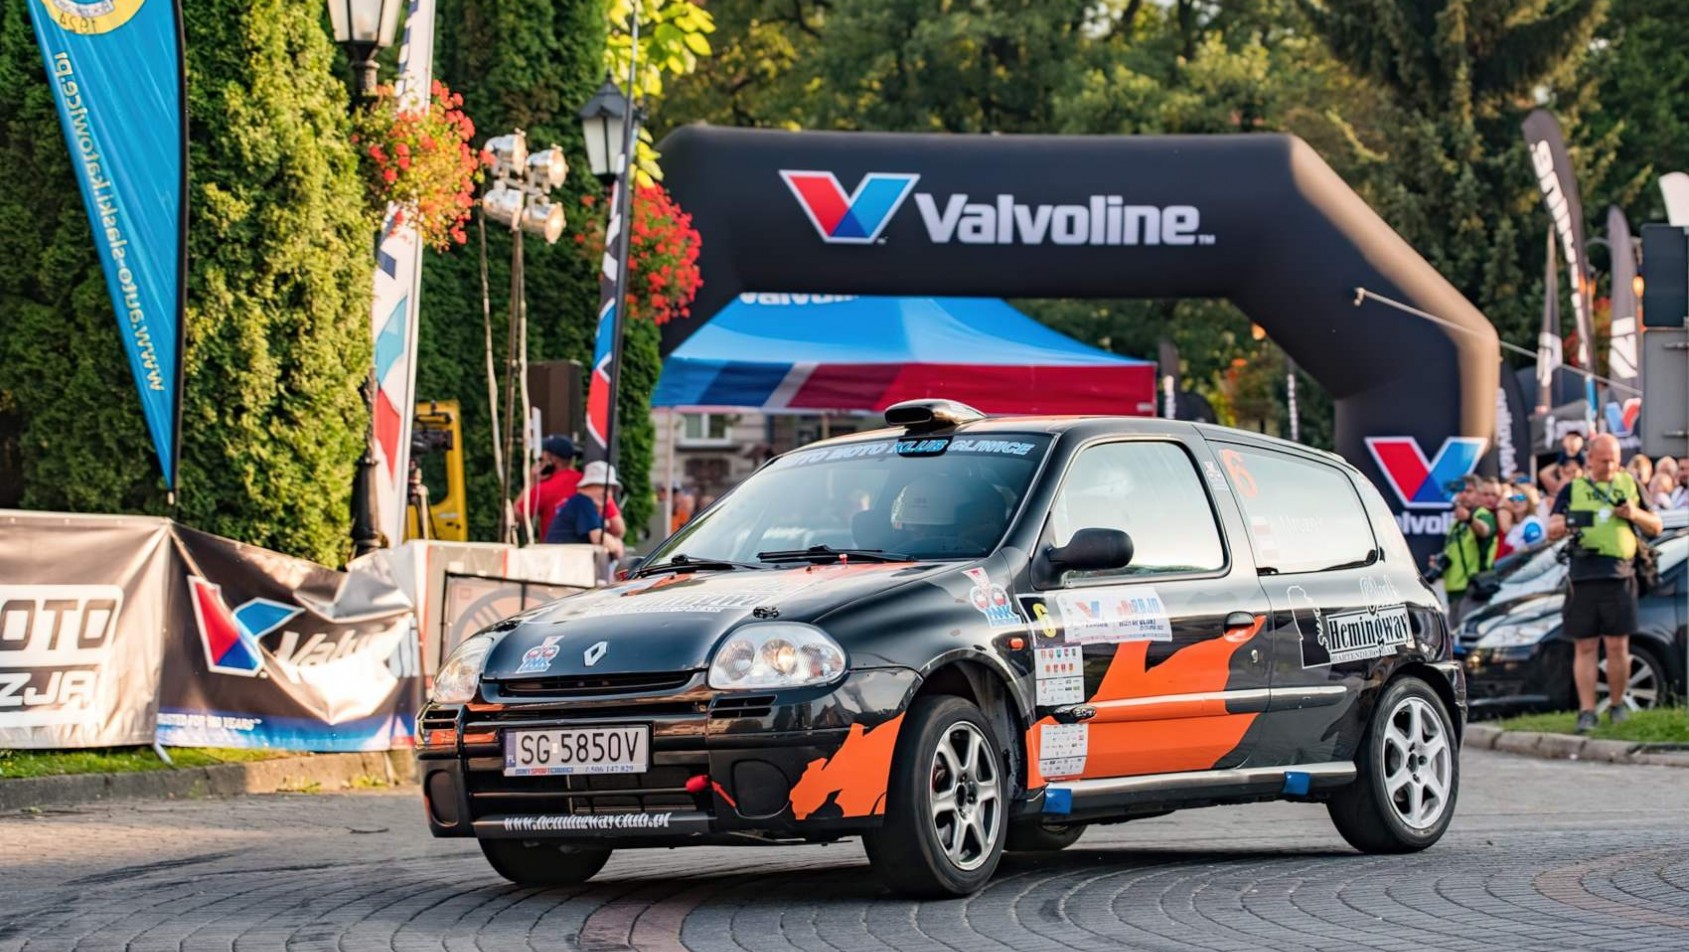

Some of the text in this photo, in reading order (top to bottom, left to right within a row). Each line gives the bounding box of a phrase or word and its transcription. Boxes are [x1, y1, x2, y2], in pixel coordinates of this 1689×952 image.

[914, 193, 1200, 245] Valvoline
[827, 442, 889, 460] MOTO
[888, 439, 949, 455] KLUB
[948, 439, 1036, 456] GLIWICE
[1220, 449, 1257, 498] 6
[1032, 603, 1056, 638] 6
[1328, 611, 1409, 650] Hemingway
[521, 731, 639, 764] SG 5850V
